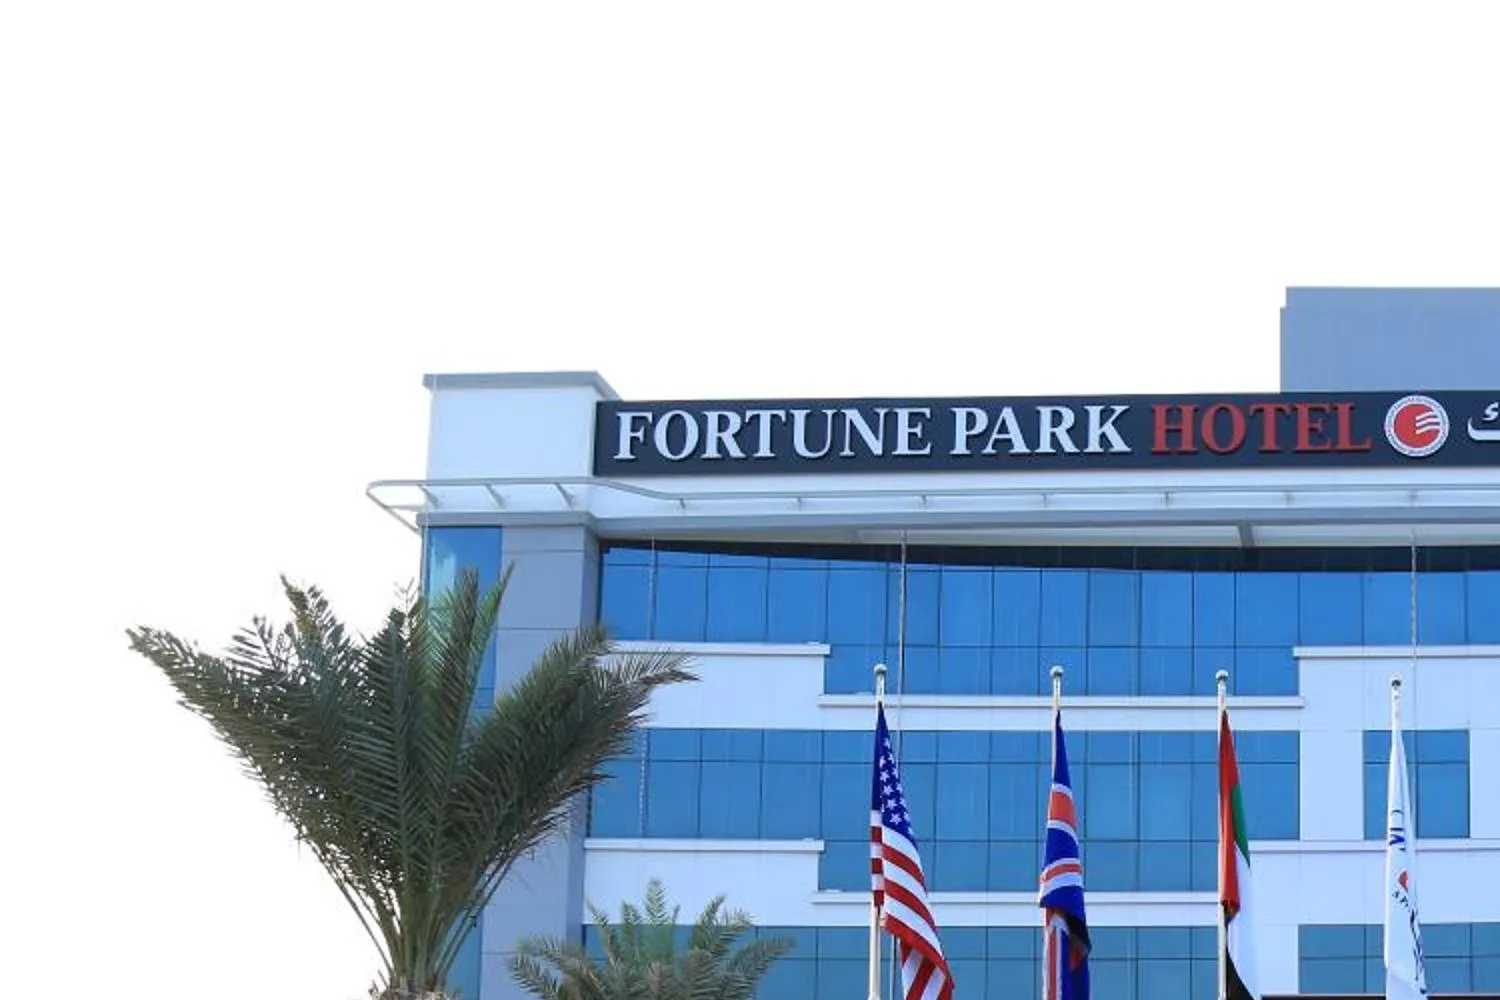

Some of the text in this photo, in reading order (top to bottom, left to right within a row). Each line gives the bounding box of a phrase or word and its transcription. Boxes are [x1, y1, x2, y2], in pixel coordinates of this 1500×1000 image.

[614, 402, 1372, 460] FORTUNE PARK HOTEL
